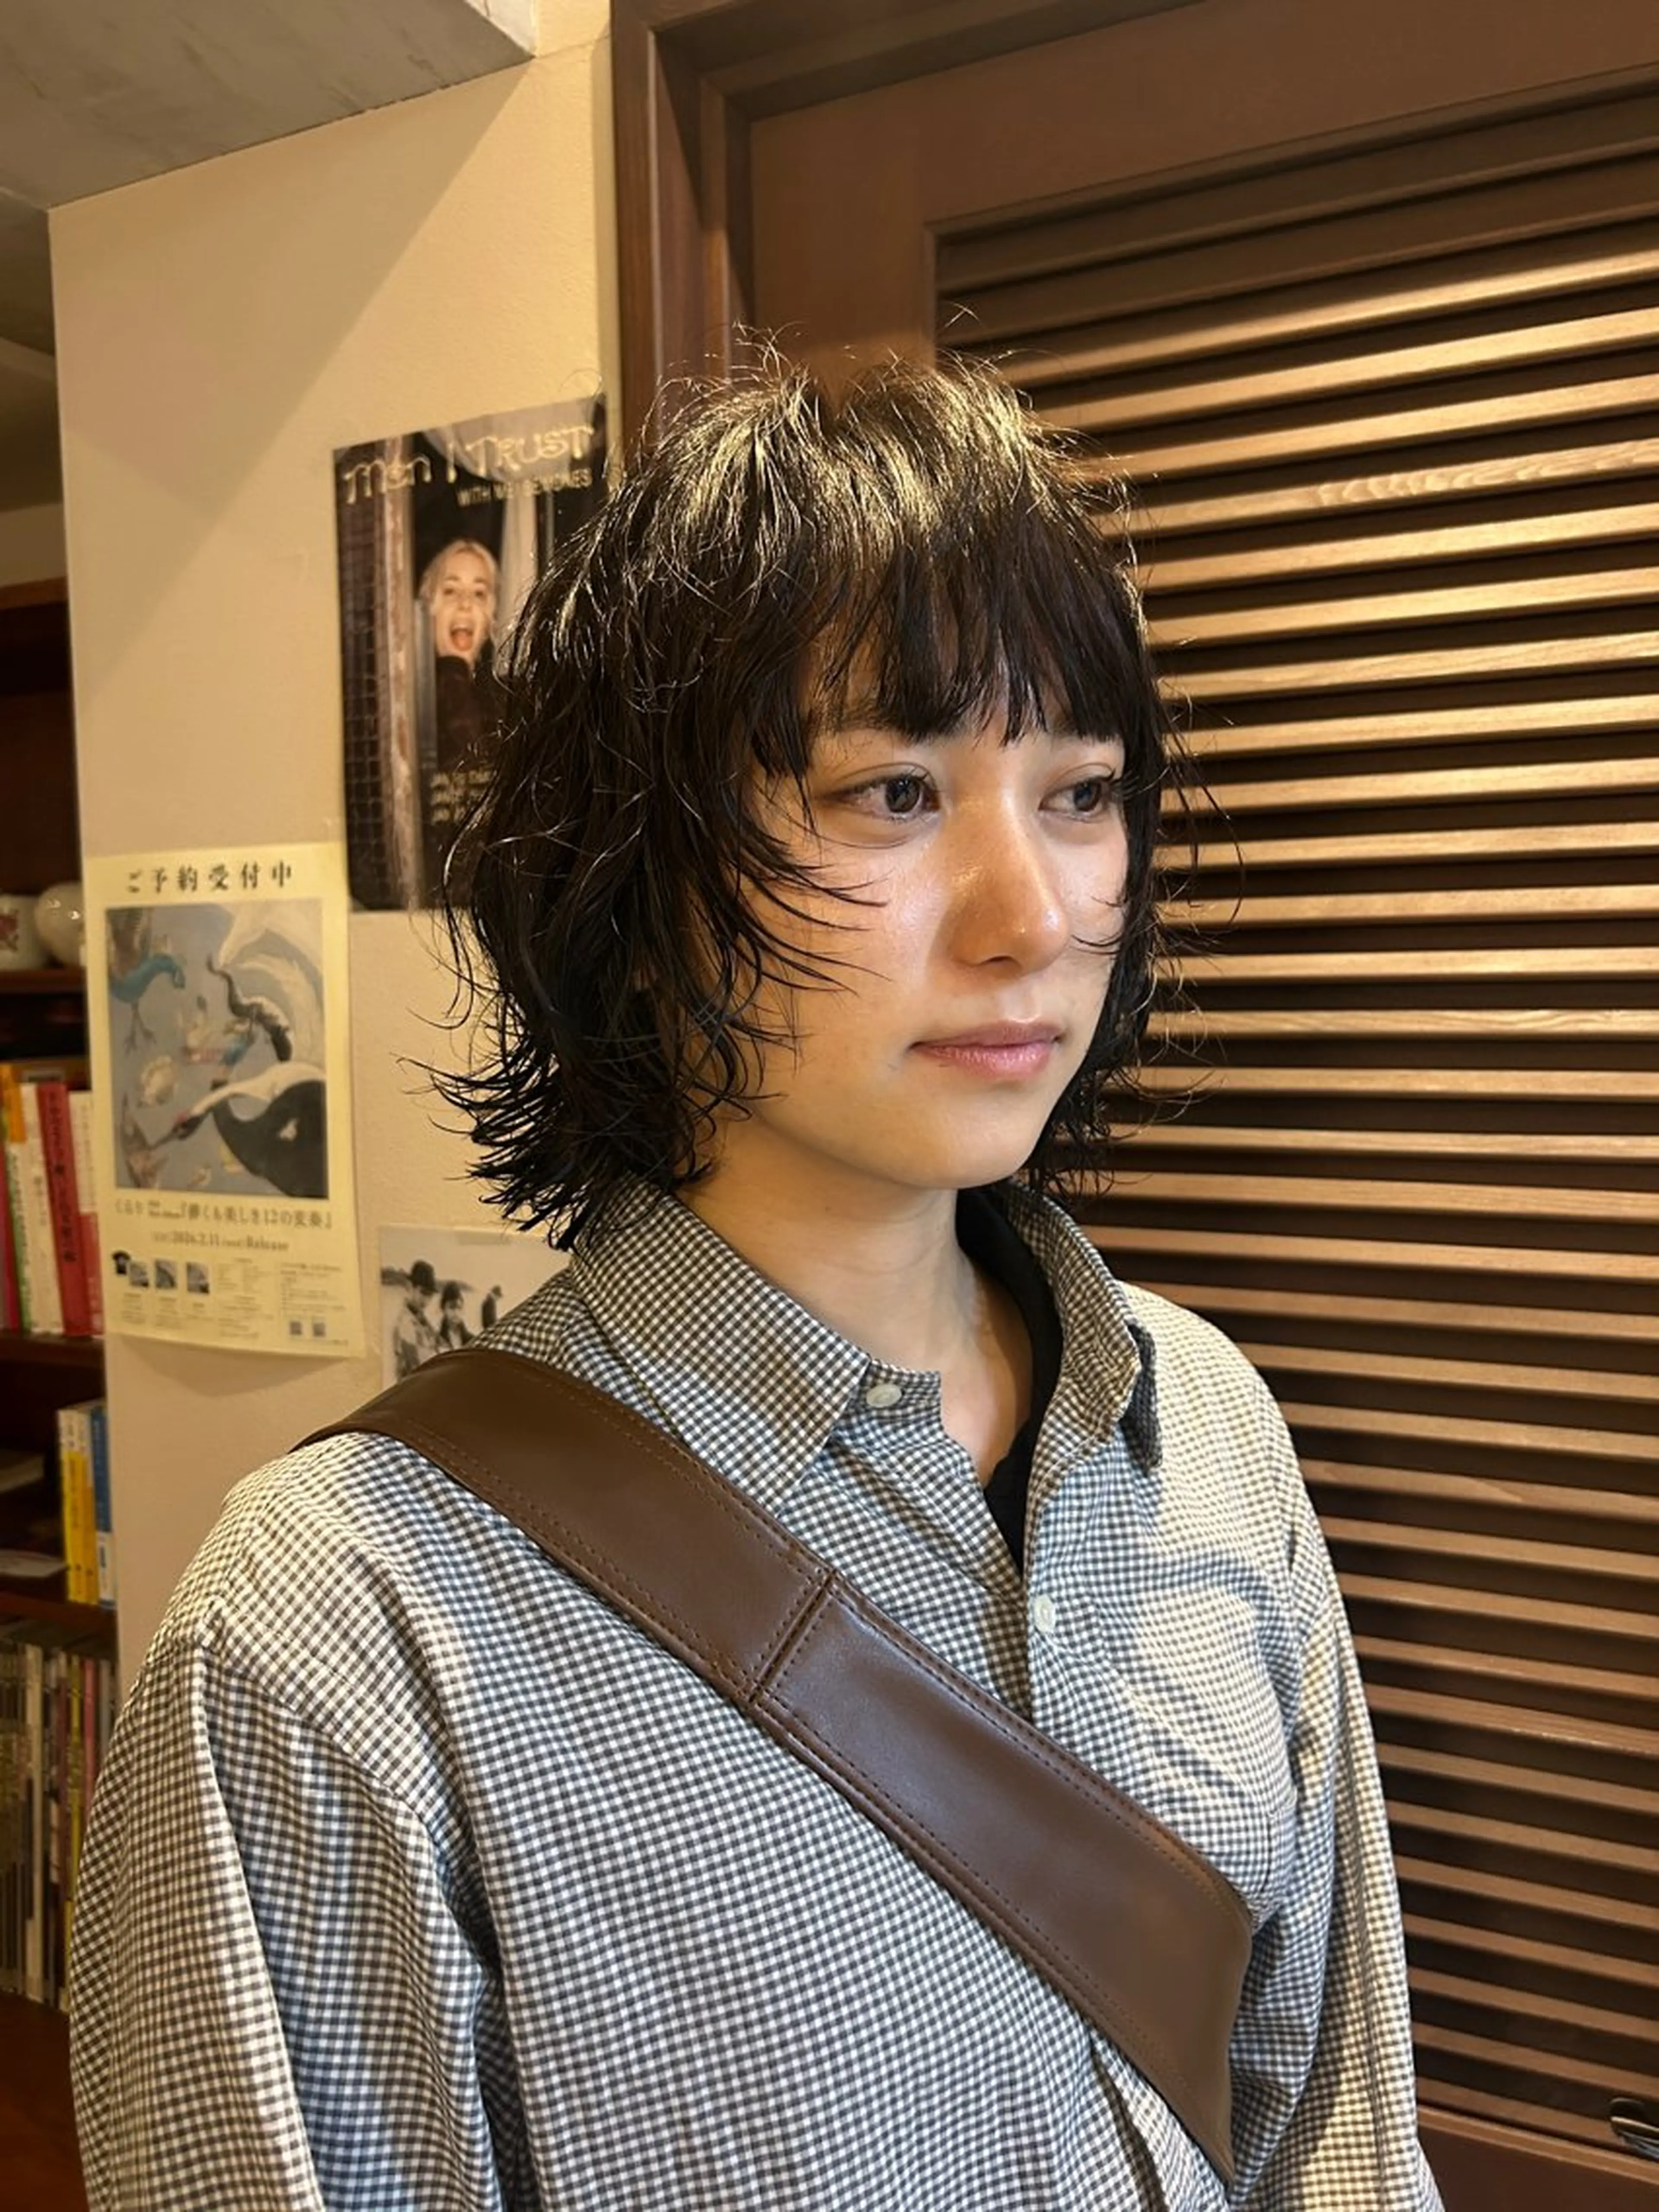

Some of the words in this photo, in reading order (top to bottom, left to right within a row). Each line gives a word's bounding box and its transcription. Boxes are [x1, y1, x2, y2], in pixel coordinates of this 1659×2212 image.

[446, 438, 458, 484] I
[464, 425, 594, 477] TRUST
[127, 860, 292, 893] ご予約受付中
